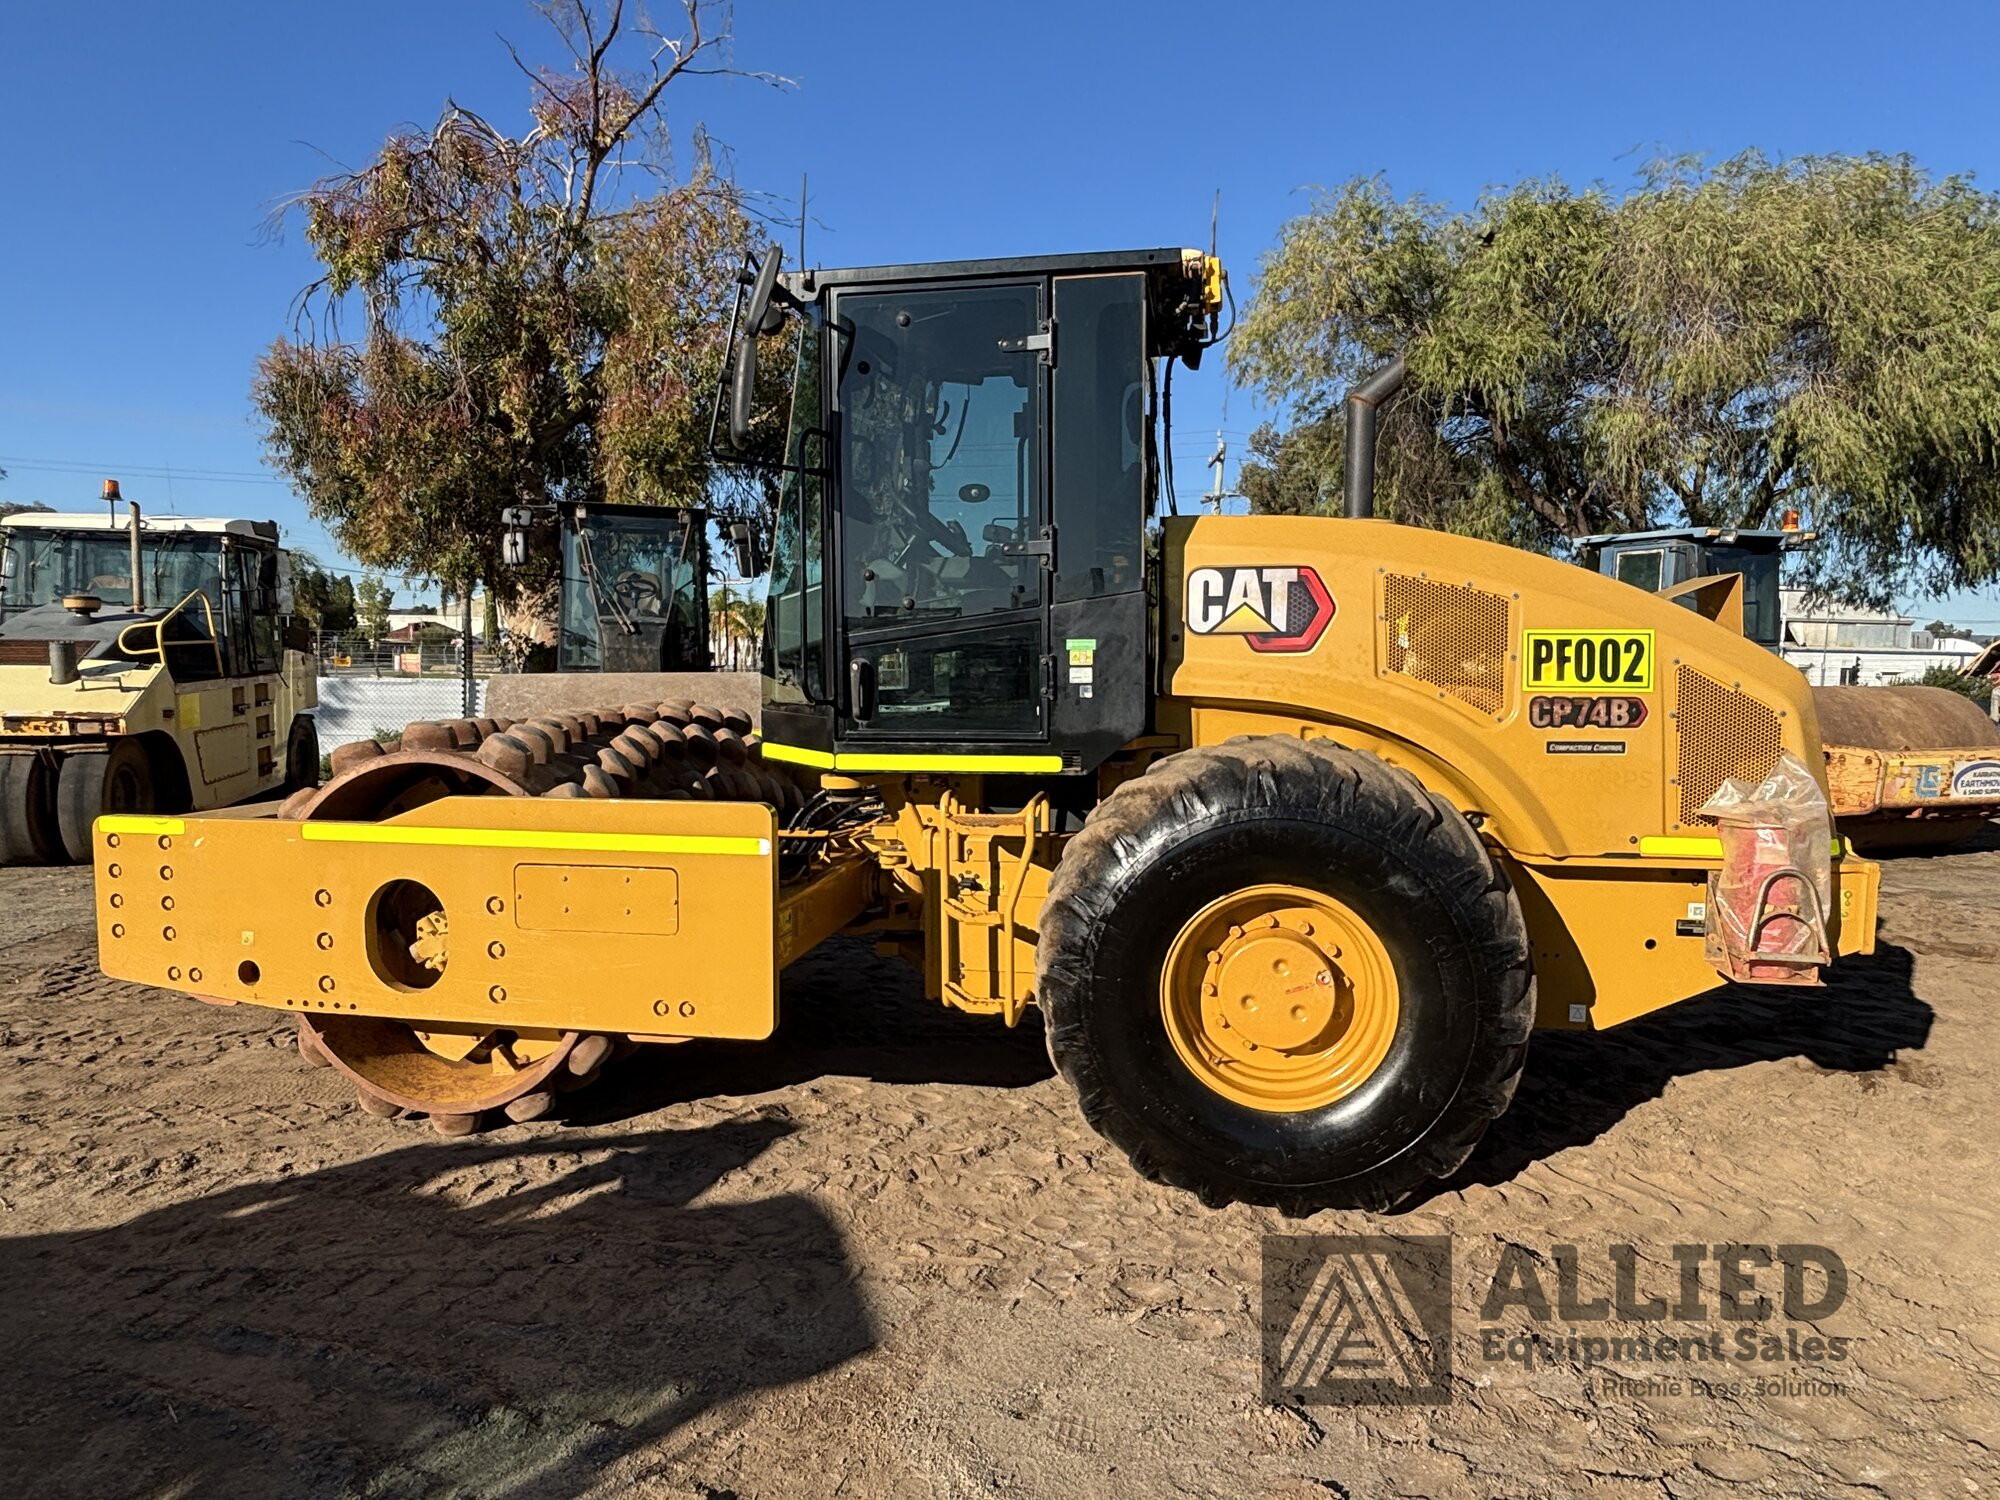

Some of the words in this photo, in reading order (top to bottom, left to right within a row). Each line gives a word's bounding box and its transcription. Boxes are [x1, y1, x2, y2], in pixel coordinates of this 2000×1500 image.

[1188, 568, 1298, 634] CAT
[1532, 638, 1645, 683] PF002
[1531, 697, 1630, 727] CP74B
